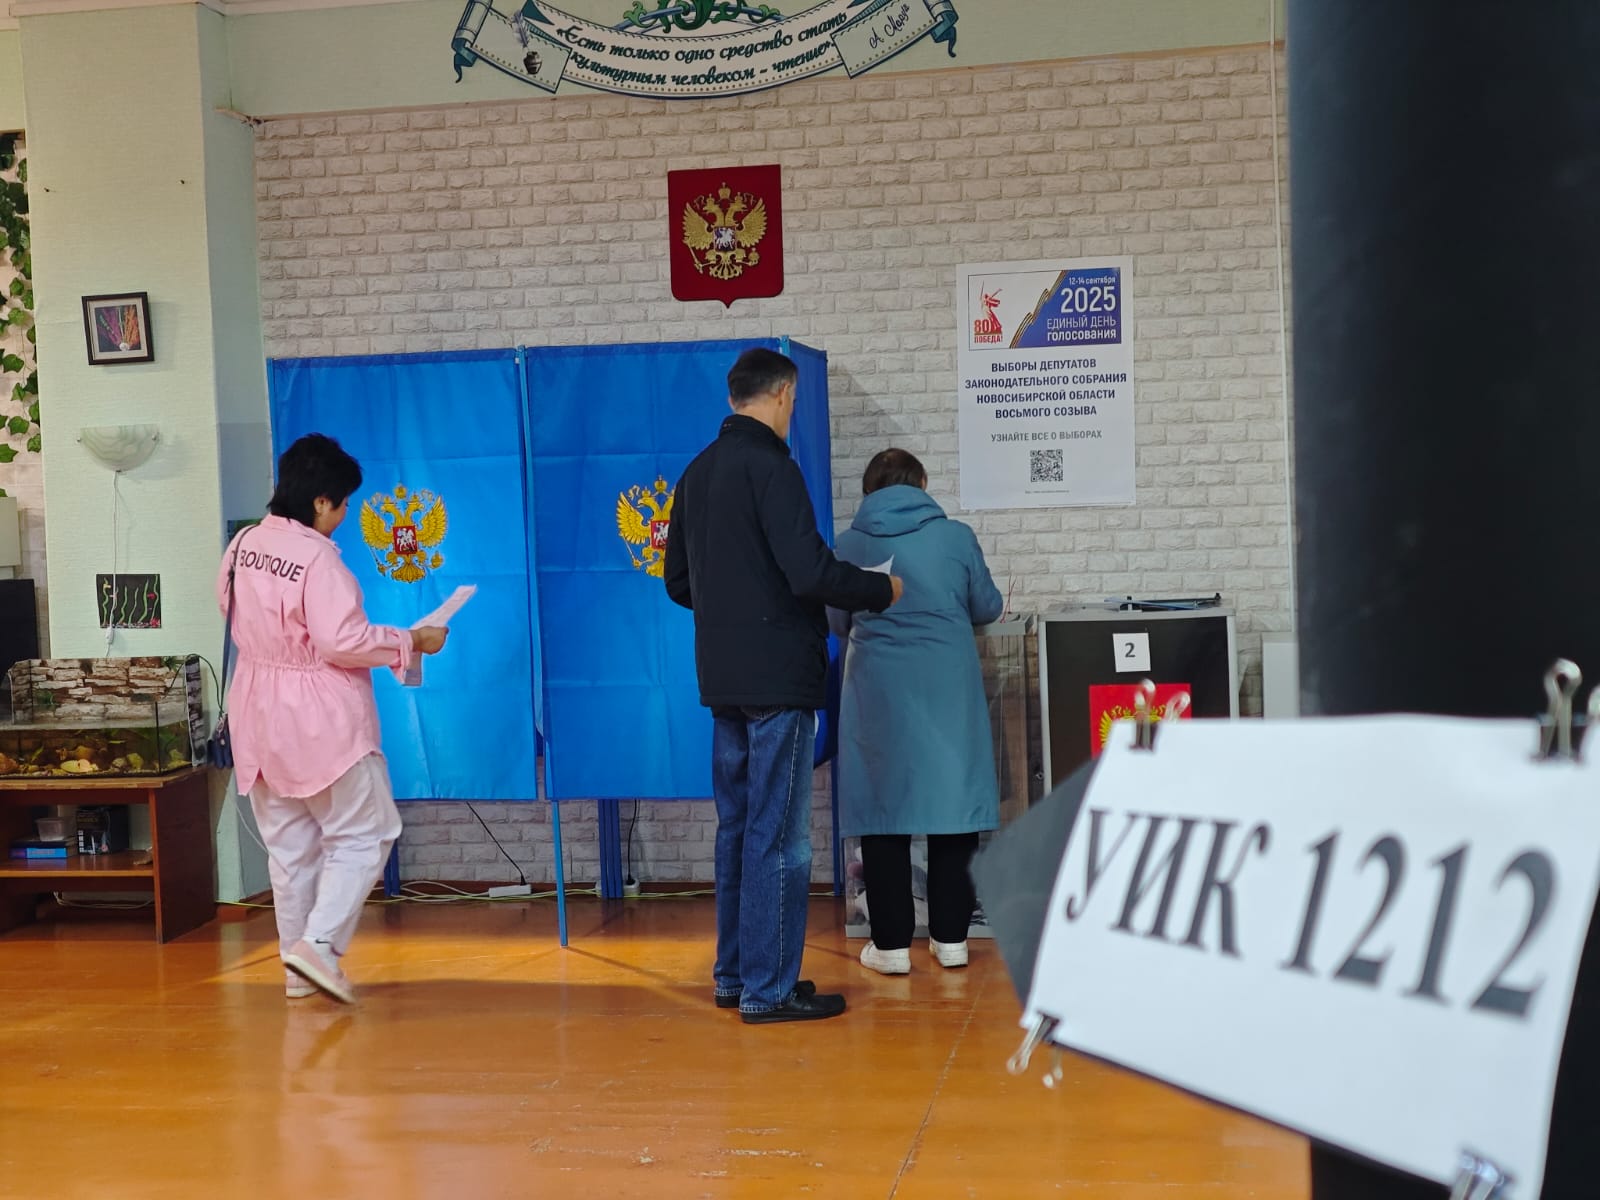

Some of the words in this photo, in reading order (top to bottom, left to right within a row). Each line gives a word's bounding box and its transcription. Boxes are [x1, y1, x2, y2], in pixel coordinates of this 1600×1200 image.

[556, 25, 606, 52] «Есть
[609, 44, 670, 61] только
[674, 48, 714, 64] одно
[719, 29, 793, 61] средство
[798, 11, 847, 41] стать
[570, 51, 666, 86] культурным
[671, 66, 755, 86] человеком
[1068, 277, 1085, 286] 12-14
[1085, 276, 1116, 285] сентября
[1060, 286, 1116, 314] 2025
[1047, 315, 1088, 330] ЕДИНЫЙ
[1090, 315, 1116, 328] ДЕНЬ
[974, 335, 1003, 344] ПОБЕДА!
[991, 361, 1037, 373] ВЫБОРЫ
[1039, 359, 1097, 372] ДЕПУТАТОВ
[965, 375, 1069, 389] ЗАКОНОДАТЕЛЬНОГО
[1072, 373, 1127, 384] СОБРАНИЯ
[977, 390, 1066, 404] НОВОСИБИРСКОЙ
[1069, 389, 1115, 401] ОБЛАСТИ
[995, 408, 1051, 419] ВОСЬМОГО
[1054, 406, 1097, 417] СОЗЫВА
[991, 431, 1029, 442] УЗНАЙТЕ
[1032, 431, 1049, 441] ВСЕ
[1051, 431, 1057, 440] О
[1059, 430, 1102, 440] ВЫБОРАХ
[240, 549, 305, 582] BOUTIQUE
[1124, 642, 1136, 658] 2
[1065, 807, 1273, 960] УИК
[1277, 827, 1559, 1024] 1212
